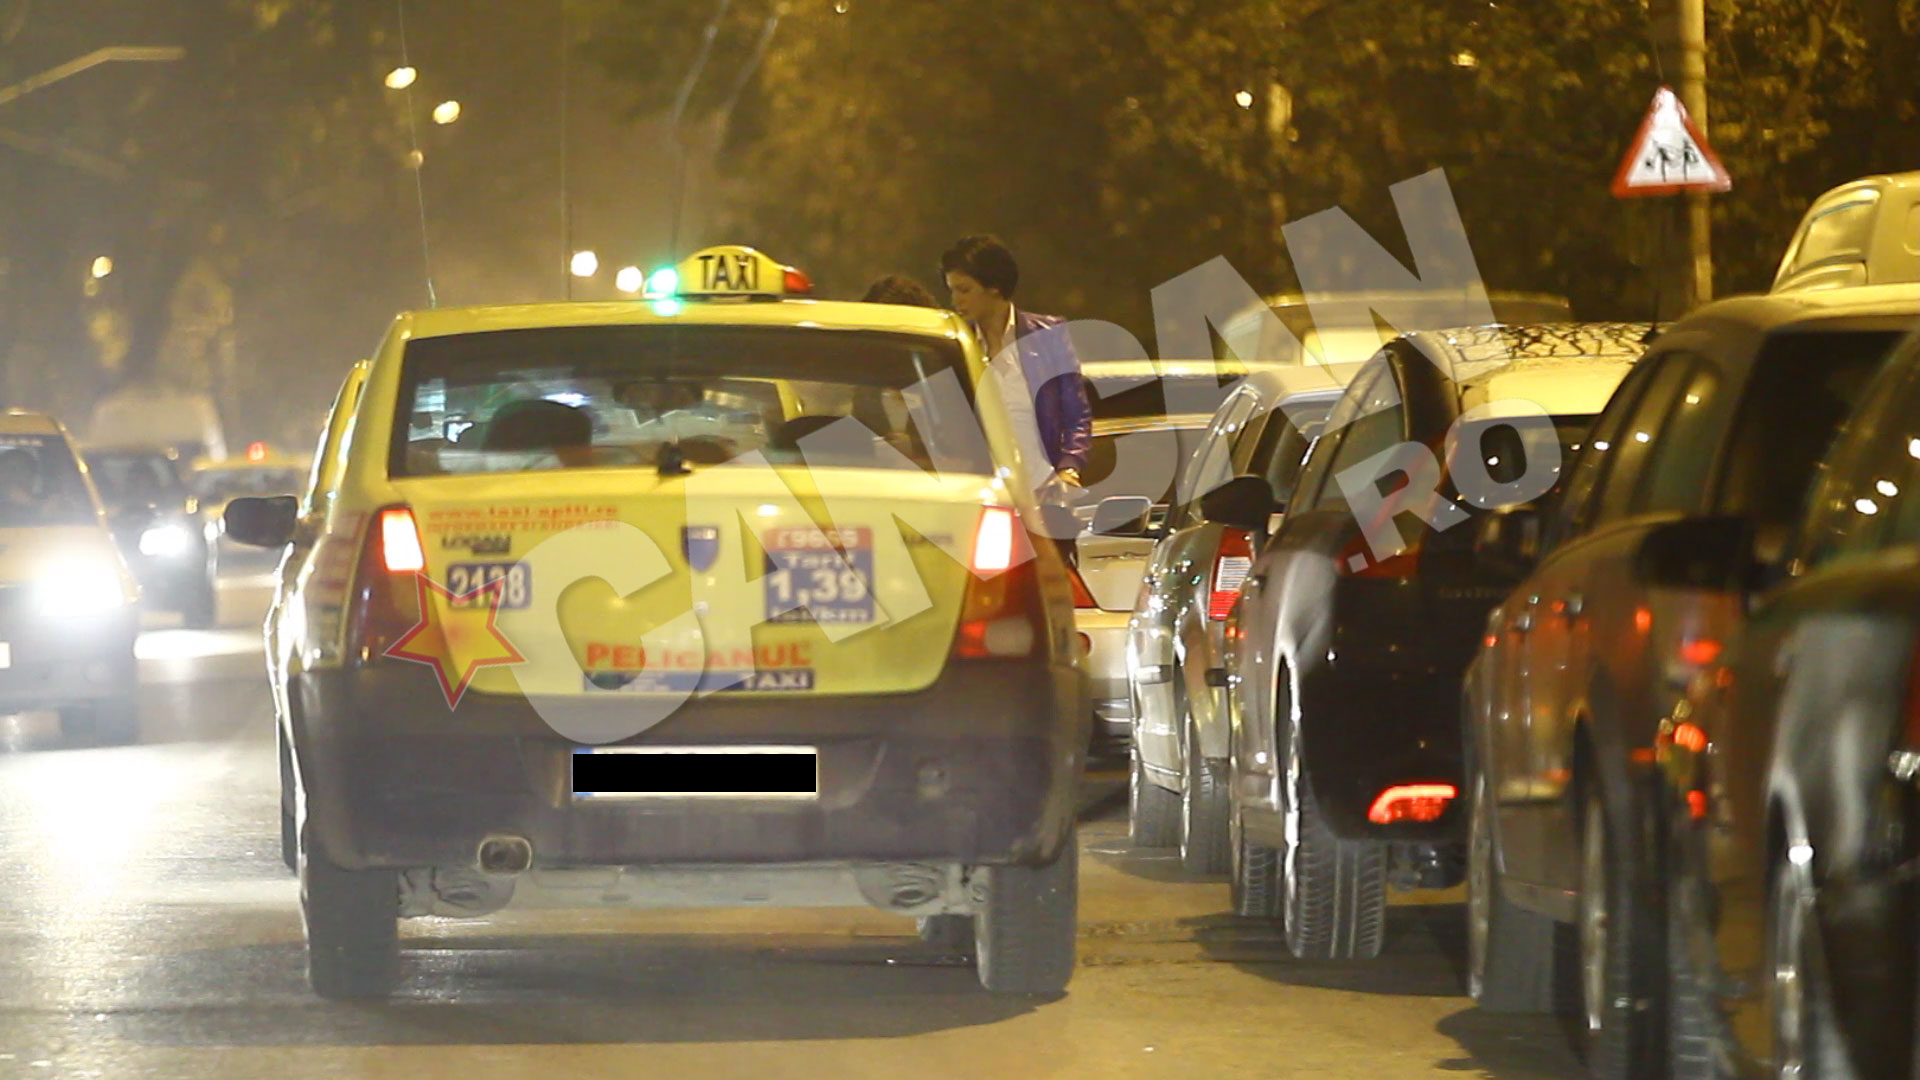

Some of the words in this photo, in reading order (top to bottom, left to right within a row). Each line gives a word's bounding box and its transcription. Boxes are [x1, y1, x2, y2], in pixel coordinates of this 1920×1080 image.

[698, 255, 757, 289] TAXI
[769, 568, 869, 605] 1,39
[744, 672, 809, 690] TAXI
